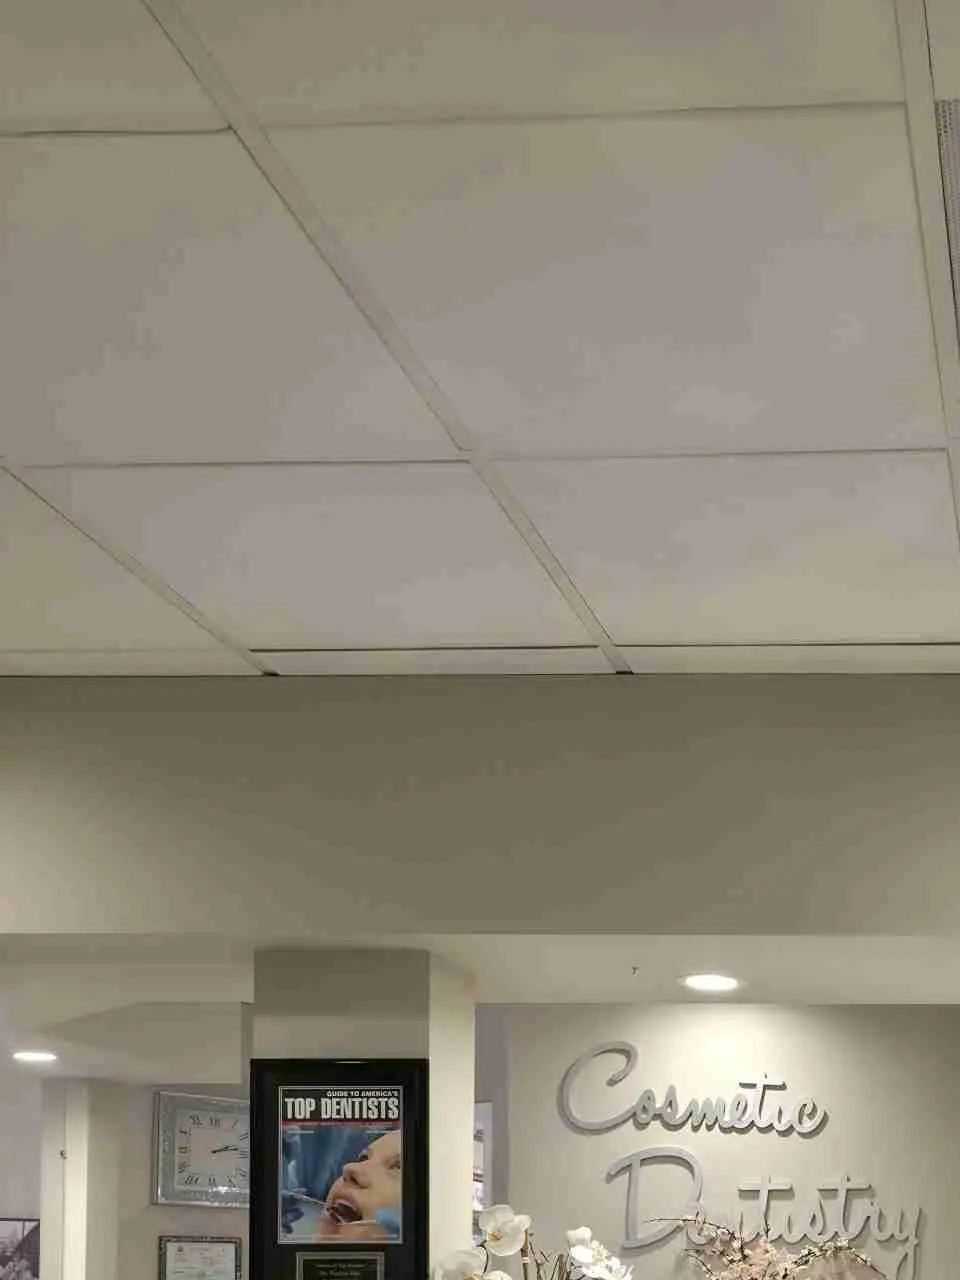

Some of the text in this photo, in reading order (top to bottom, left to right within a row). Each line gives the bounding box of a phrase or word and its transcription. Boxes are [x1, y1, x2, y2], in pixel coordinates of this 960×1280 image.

[284, 1098, 399, 1120] TOP DENTISTS
[557, 1041, 827, 1137] Cosmetic
